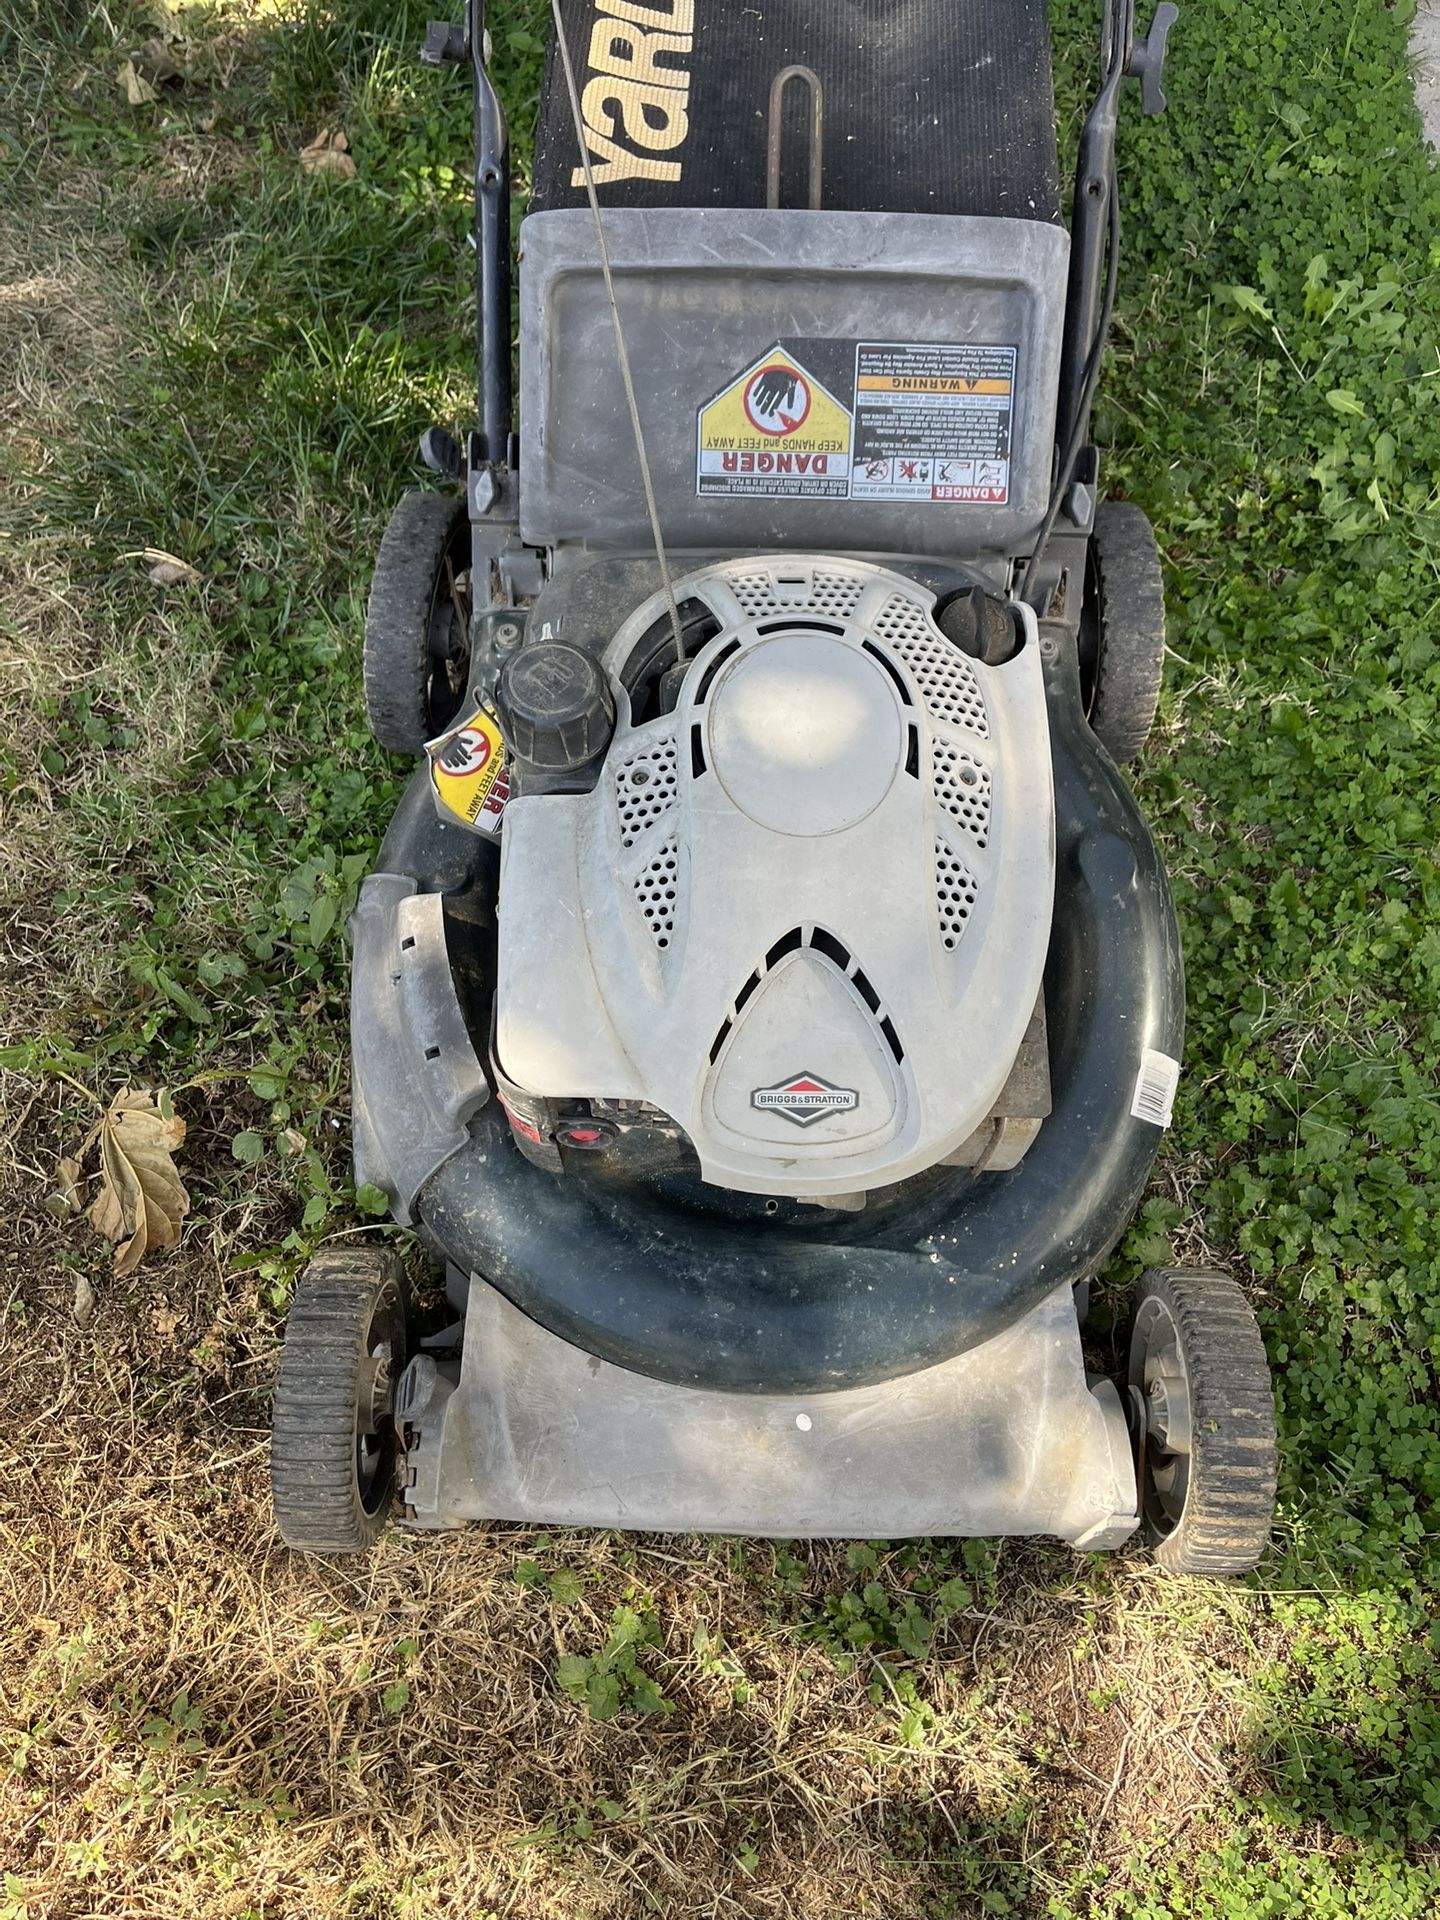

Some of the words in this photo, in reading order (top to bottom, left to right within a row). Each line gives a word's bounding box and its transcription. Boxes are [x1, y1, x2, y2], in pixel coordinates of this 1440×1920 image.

[892, 378, 959, 390] WARNING
[706, 436, 734, 447] AWAY
[738, 437, 760, 448] FEET
[764, 438, 779, 449] and
[782, 439, 815, 450] HANDS
[817, 440, 842, 451] KEEP
[722, 451, 827, 474] DANGER
[936, 486, 988, 497] DANGER
[487, 759, 500, 775] and
[478, 773, 493, 795] FEET
[466, 794, 482, 818] AWAY
[760, 1095, 850, 1104] BRIGGS&STRATTON
